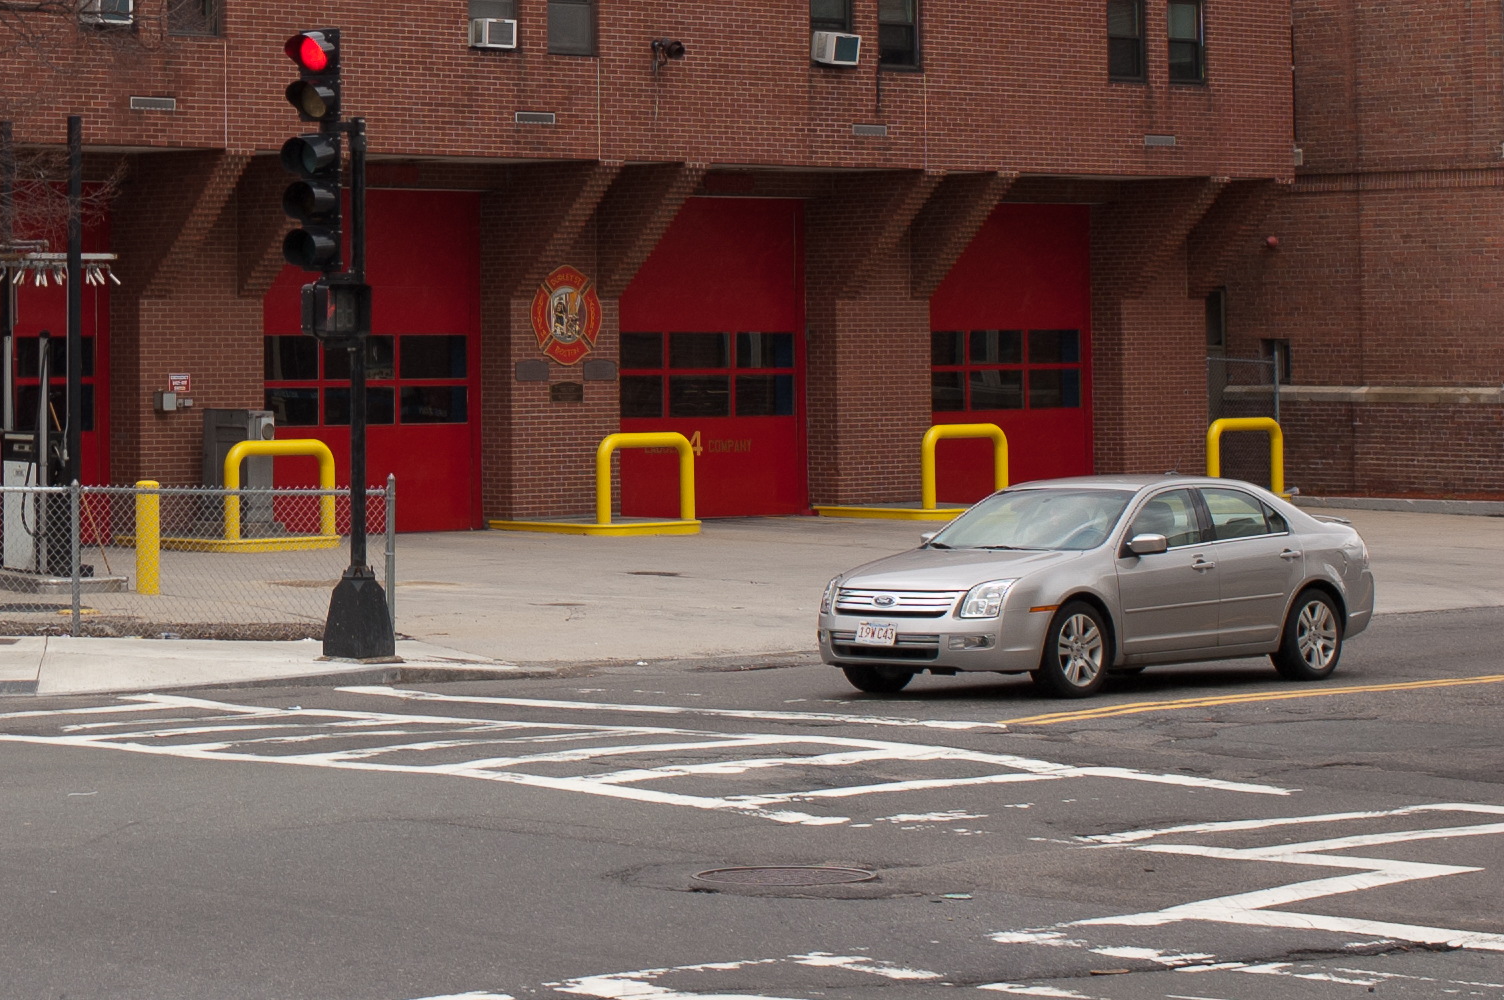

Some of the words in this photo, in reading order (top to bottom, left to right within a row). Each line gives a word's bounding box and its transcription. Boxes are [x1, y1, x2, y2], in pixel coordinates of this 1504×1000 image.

[554, 345, 580, 357] BOSTON
[690, 430, 703, 456] 4
[708, 440, 753, 453] COMPANY
